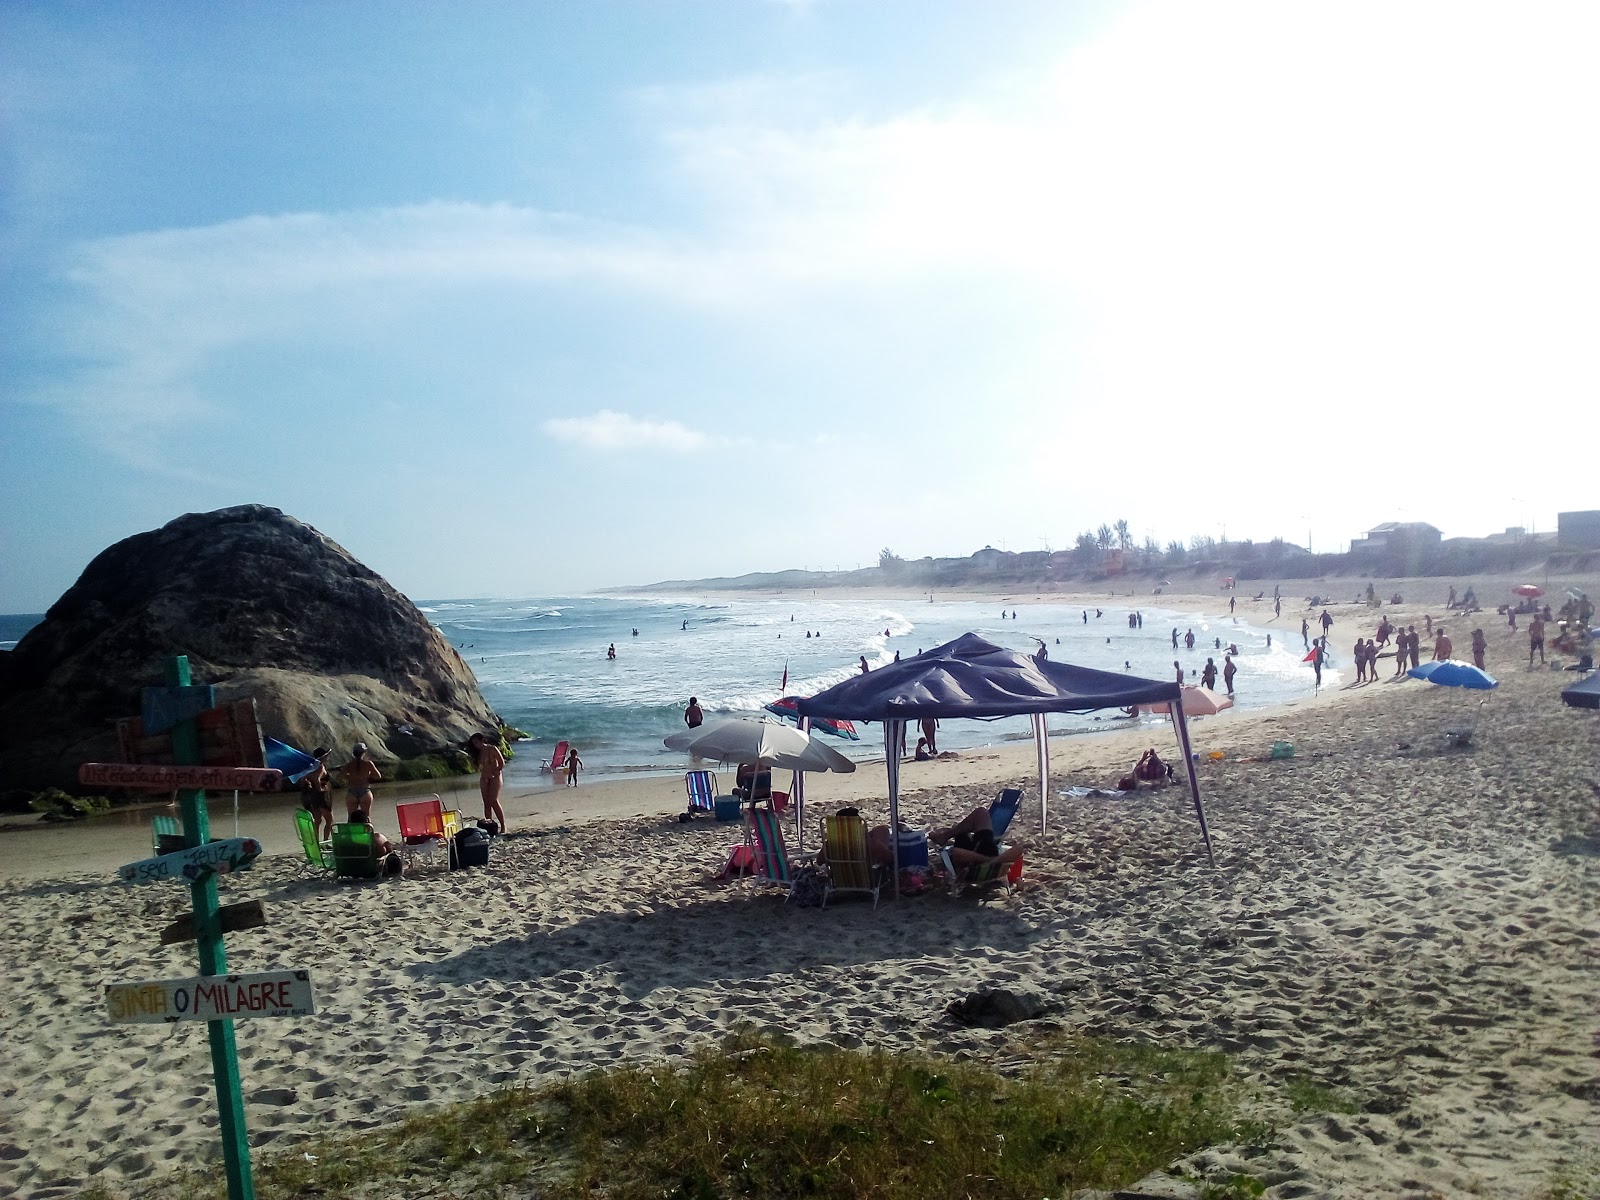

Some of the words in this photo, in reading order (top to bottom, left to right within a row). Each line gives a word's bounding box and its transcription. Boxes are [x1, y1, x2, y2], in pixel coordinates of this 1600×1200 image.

[110, 984, 168, 1019] SINTA
[174, 987, 190, 1013] O
[193, 981, 294, 1014] MILAGRE
